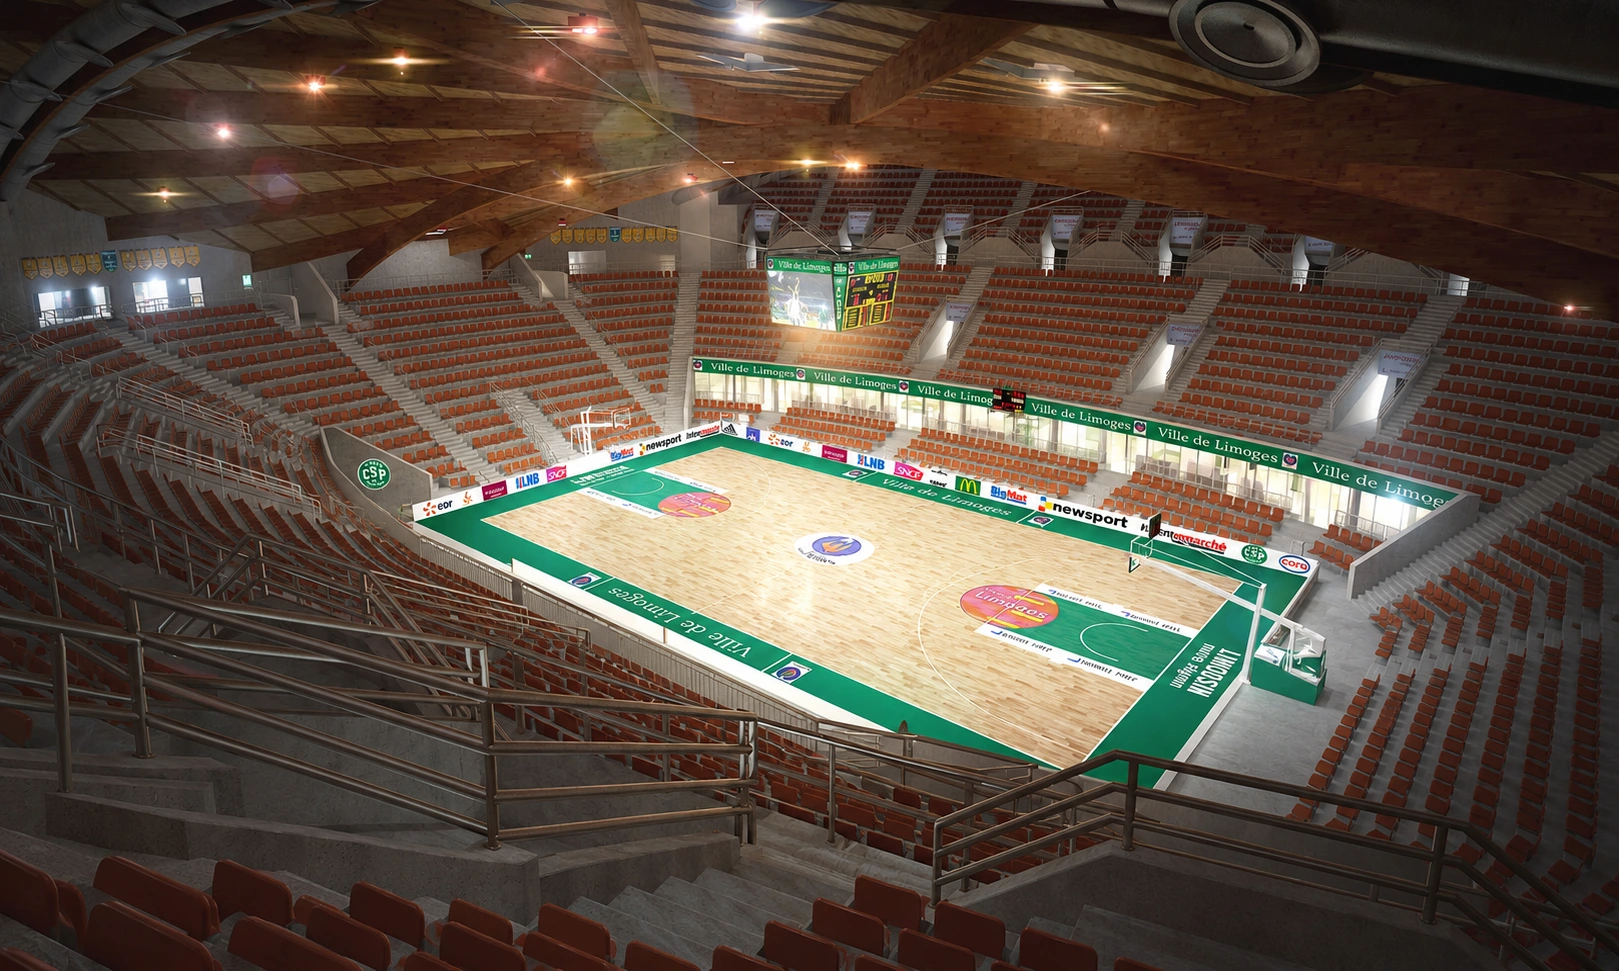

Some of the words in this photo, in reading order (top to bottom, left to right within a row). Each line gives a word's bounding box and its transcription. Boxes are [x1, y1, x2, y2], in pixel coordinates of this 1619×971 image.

[711, 362, 733, 373] Ville
[736, 364, 749, 374] de
[753, 366, 795, 379] Limoges
[813, 371, 836, 383] Ville
[839, 374, 852, 385] de
[855, 375, 897, 391] Limoges
[917, 385, 941, 397] Ville
[943, 387, 957, 399] de
[960, 390, 994, 407] Limog
[1031, 402, 1057, 418] Ville
[1060, 405, 1075, 420] de
[1079, 409, 1131, 433] Limoges
[645, 433, 682, 451] newsport
[1158, 426, 1189, 444] Ville
[1193, 431, 1210, 447] de
[1215, 436, 1278, 464] Limoges
[362, 466, 387, 480] CSP
[1311, 460, 1351, 482] Ville
[1353, 471, 1378, 490] de
[990, 485, 1028, 502] BigMat
[1052, 503, 1128, 528] newsport
[607, 587, 681, 624] Limoges
[680, 619, 706, 634] de
[707, 631, 752, 658] Ville
